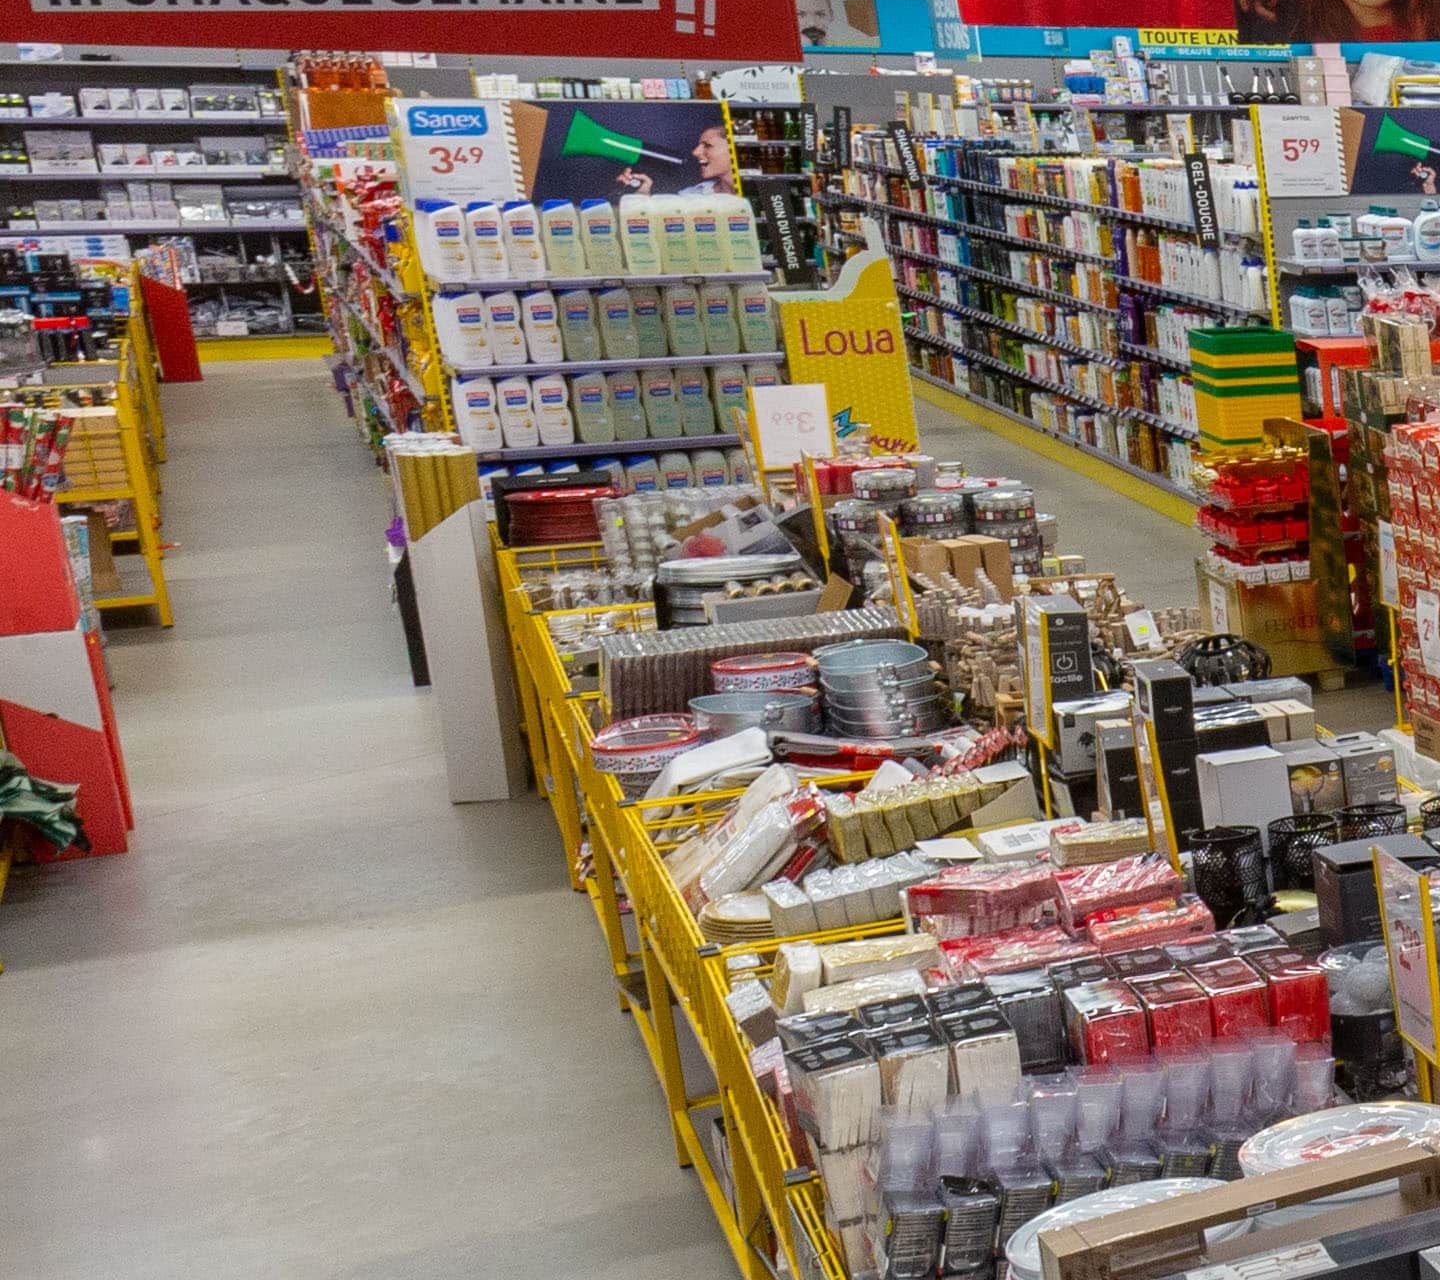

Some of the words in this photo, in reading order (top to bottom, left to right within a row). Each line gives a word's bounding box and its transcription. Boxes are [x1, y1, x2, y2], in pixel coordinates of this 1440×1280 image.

[1143, 30, 1201, 46] TOUTE
[1205, 31, 1239, 47] L'AN
[412, 107, 484, 136] Sanex
[431, 145, 485, 175] 349
[1283, 138, 1321, 162] 599
[1190, 161, 1214, 241] GEL-DOUCHE
[799, 319, 896, 359] Loua
